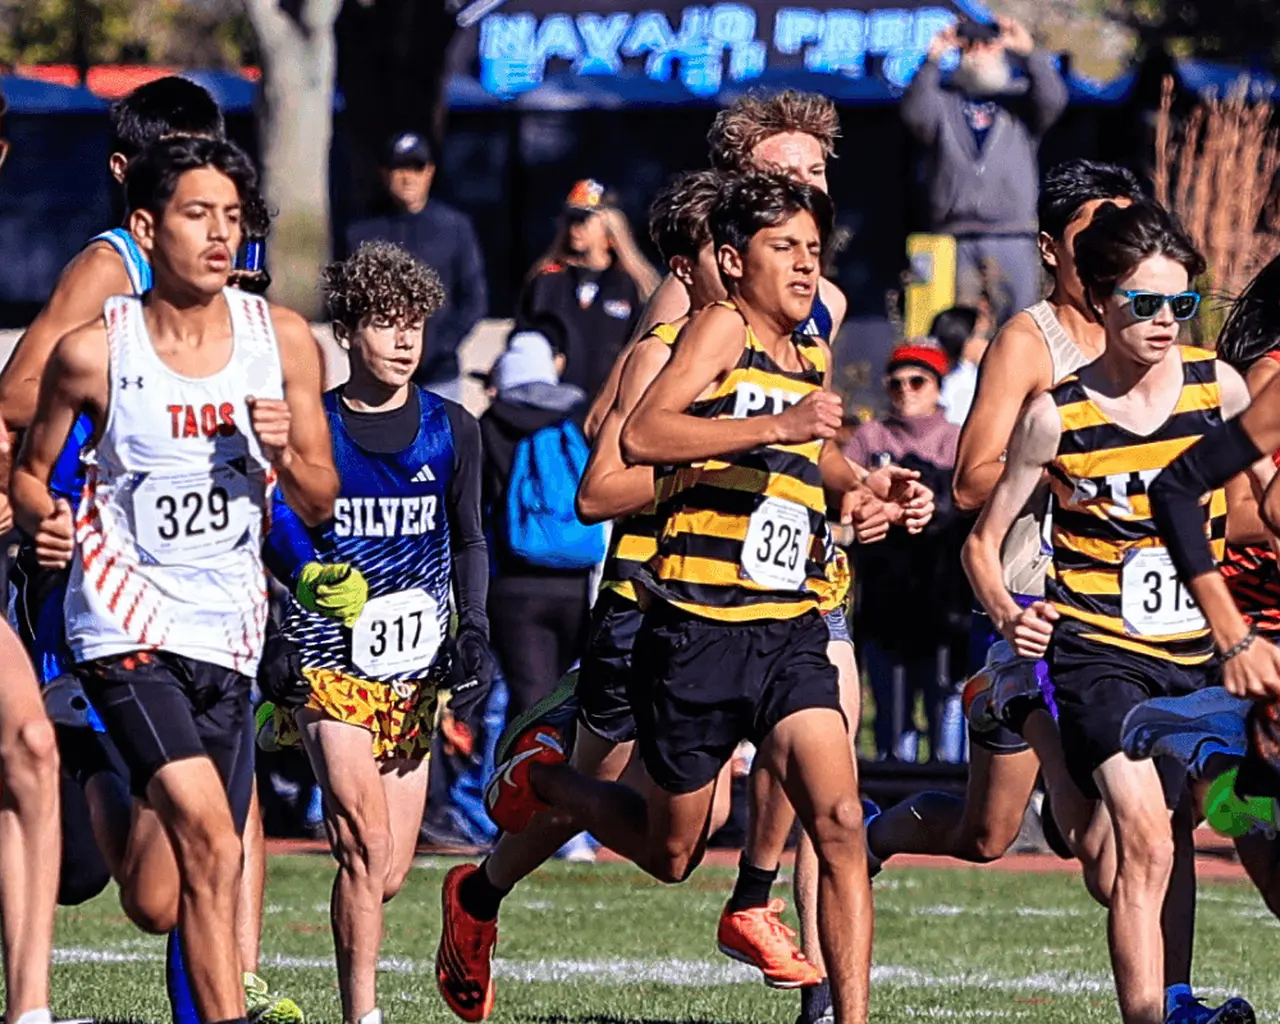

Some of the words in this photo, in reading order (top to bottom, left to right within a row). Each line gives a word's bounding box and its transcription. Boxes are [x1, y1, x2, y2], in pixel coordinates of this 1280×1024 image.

[166, 402, 237, 439] TAOS
[156, 486, 230, 541] 329
[334, 495, 438, 537] SILVER
[756, 520, 802, 571] 325
[370, 611, 424, 657] 317
